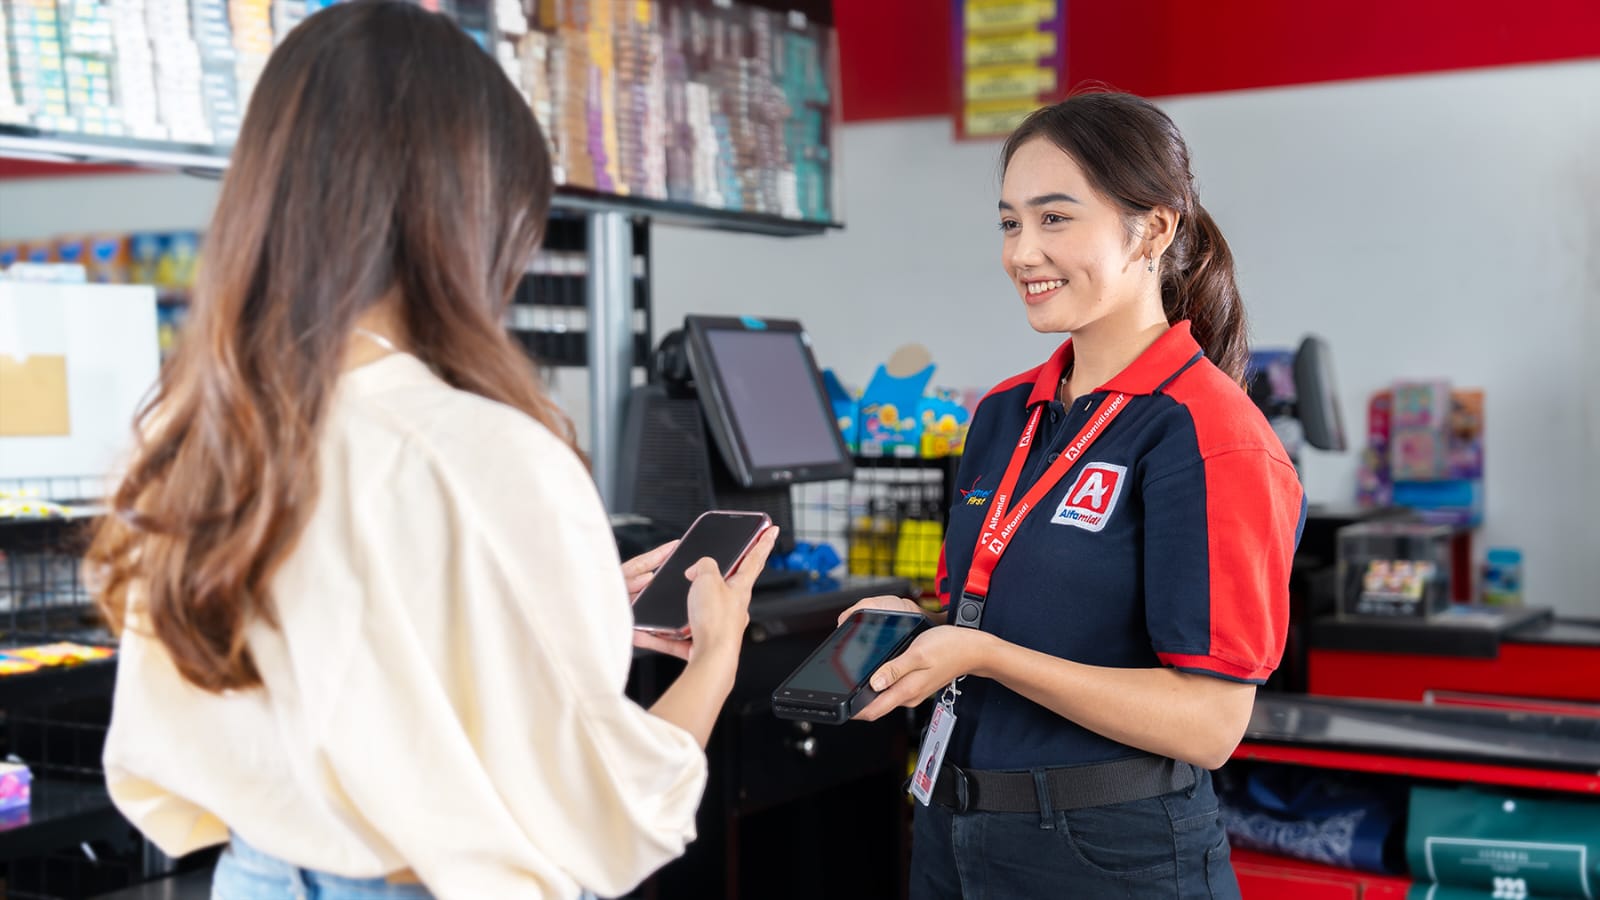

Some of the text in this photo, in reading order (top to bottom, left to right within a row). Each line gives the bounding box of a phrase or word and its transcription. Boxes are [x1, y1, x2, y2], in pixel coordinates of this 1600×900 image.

[1072, 471, 1110, 509] A
[988, 494, 1007, 530] Alfamidi
[1000, 503, 1029, 539] Alfamidi
[1059, 508, 1101, 526] Alfamidi
